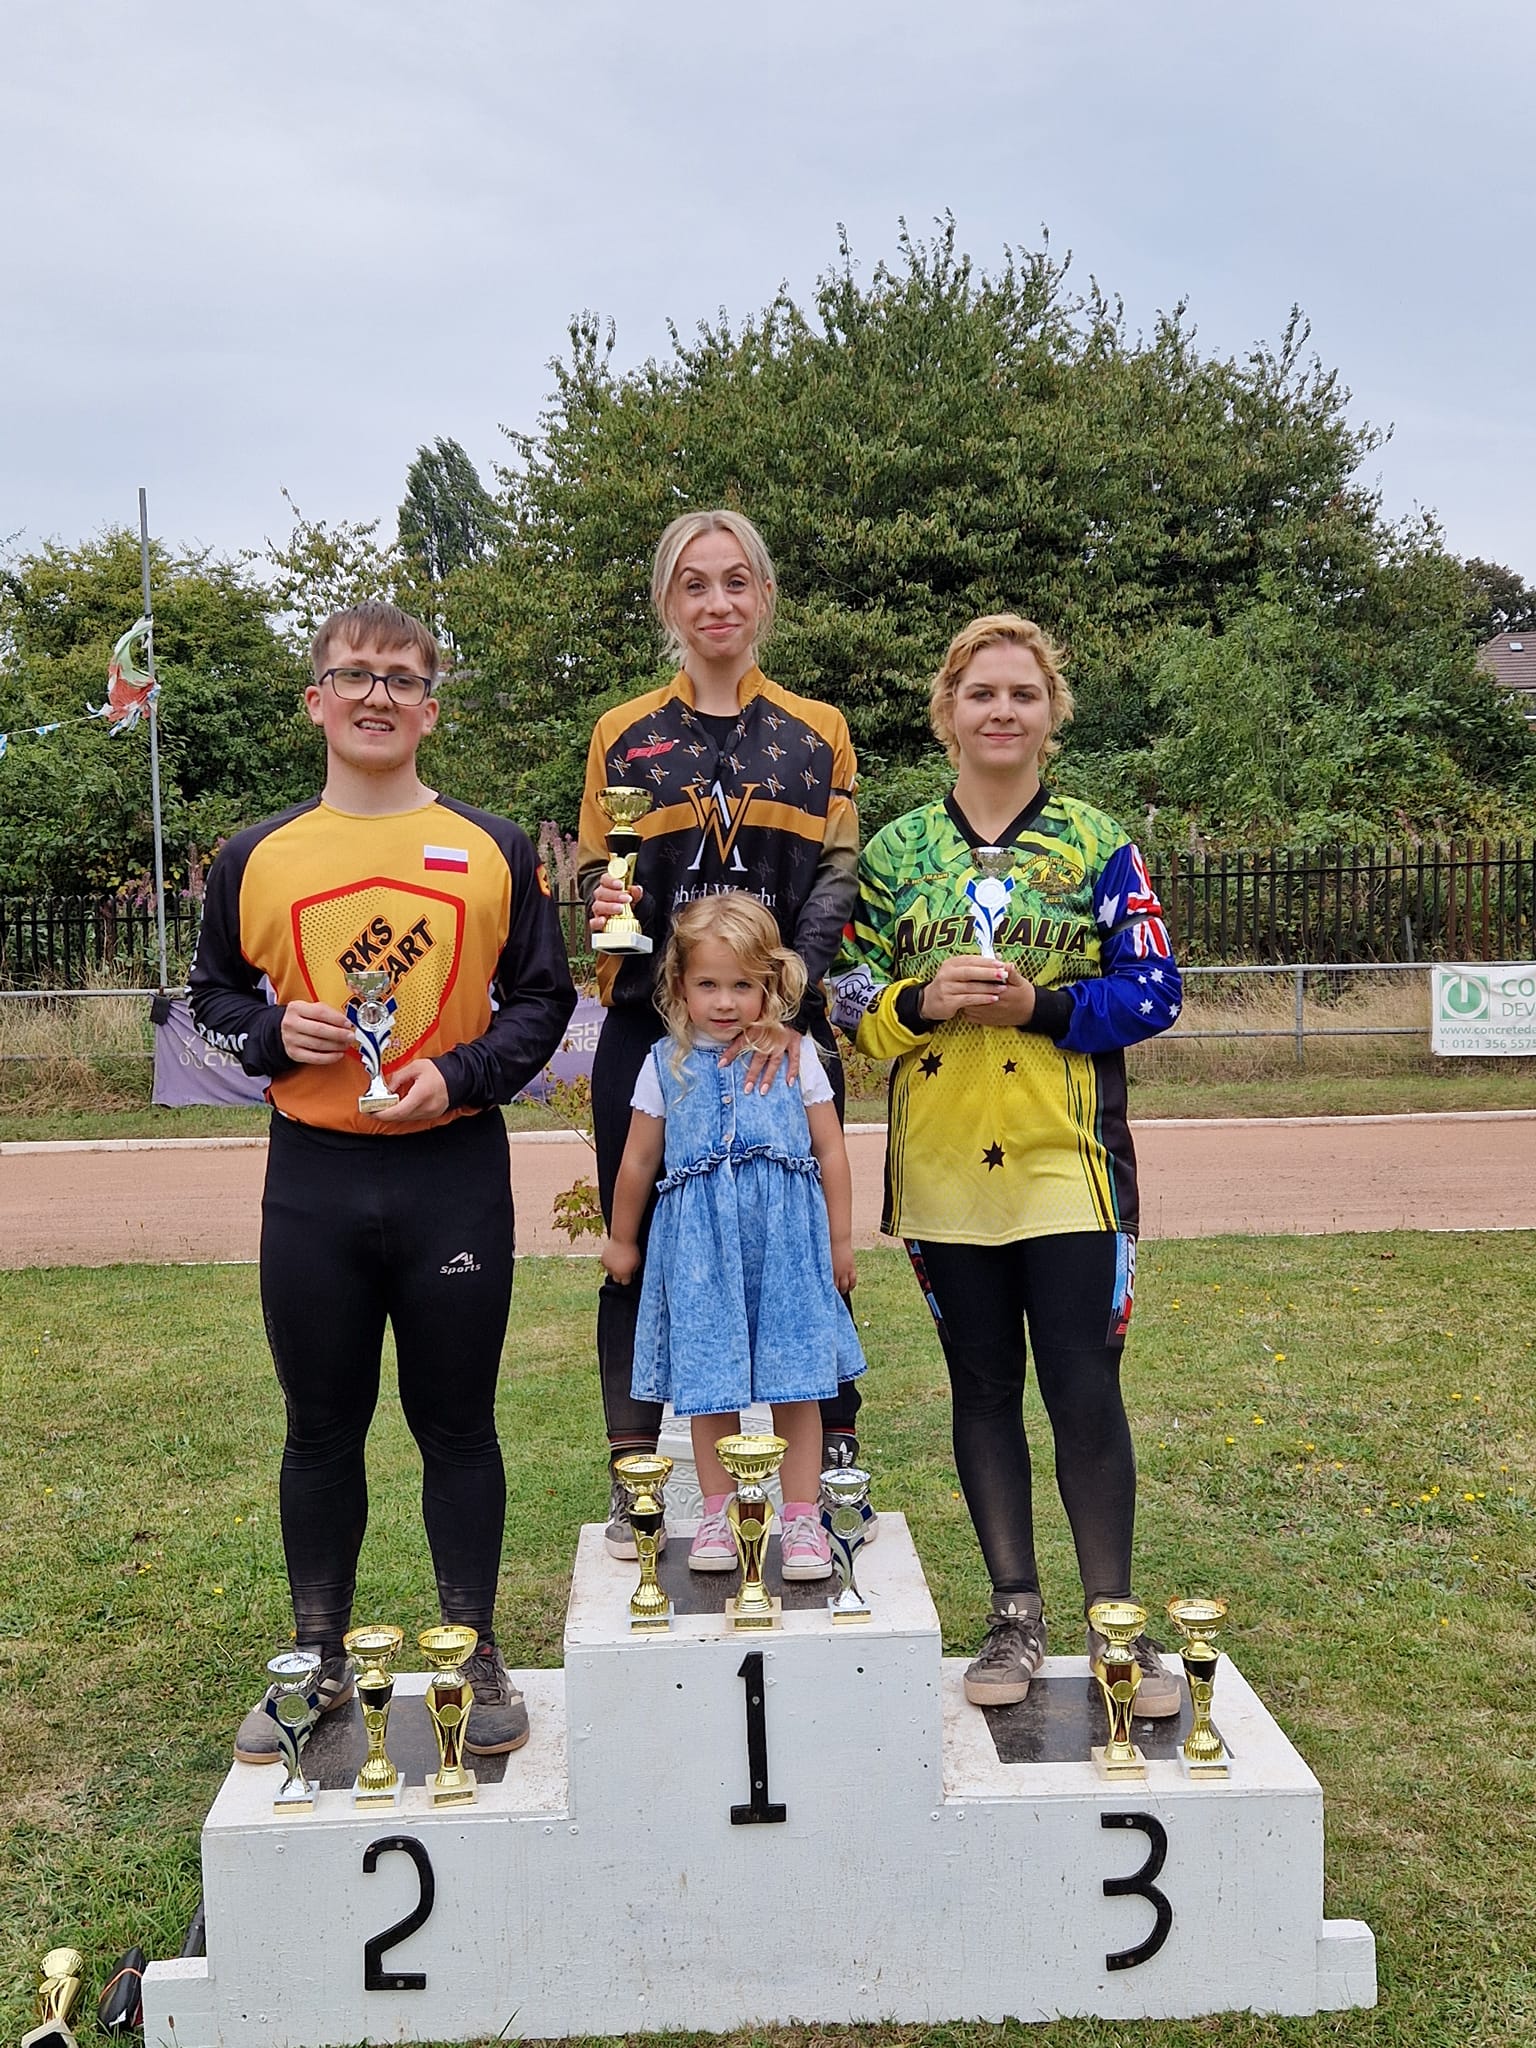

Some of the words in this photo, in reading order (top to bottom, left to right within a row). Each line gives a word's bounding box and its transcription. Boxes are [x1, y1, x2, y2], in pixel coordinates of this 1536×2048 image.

[338, 917, 393, 974] RKS
[1452, 1039, 1480, 1049] 0121
[1485, 1039, 1507, 1049] 356
[440, 1263, 481, 1275] Sports
[731, 1651, 787, 1825] 1
[363, 1835, 435, 1991] 2
[1100, 1812, 1174, 1971] 3
